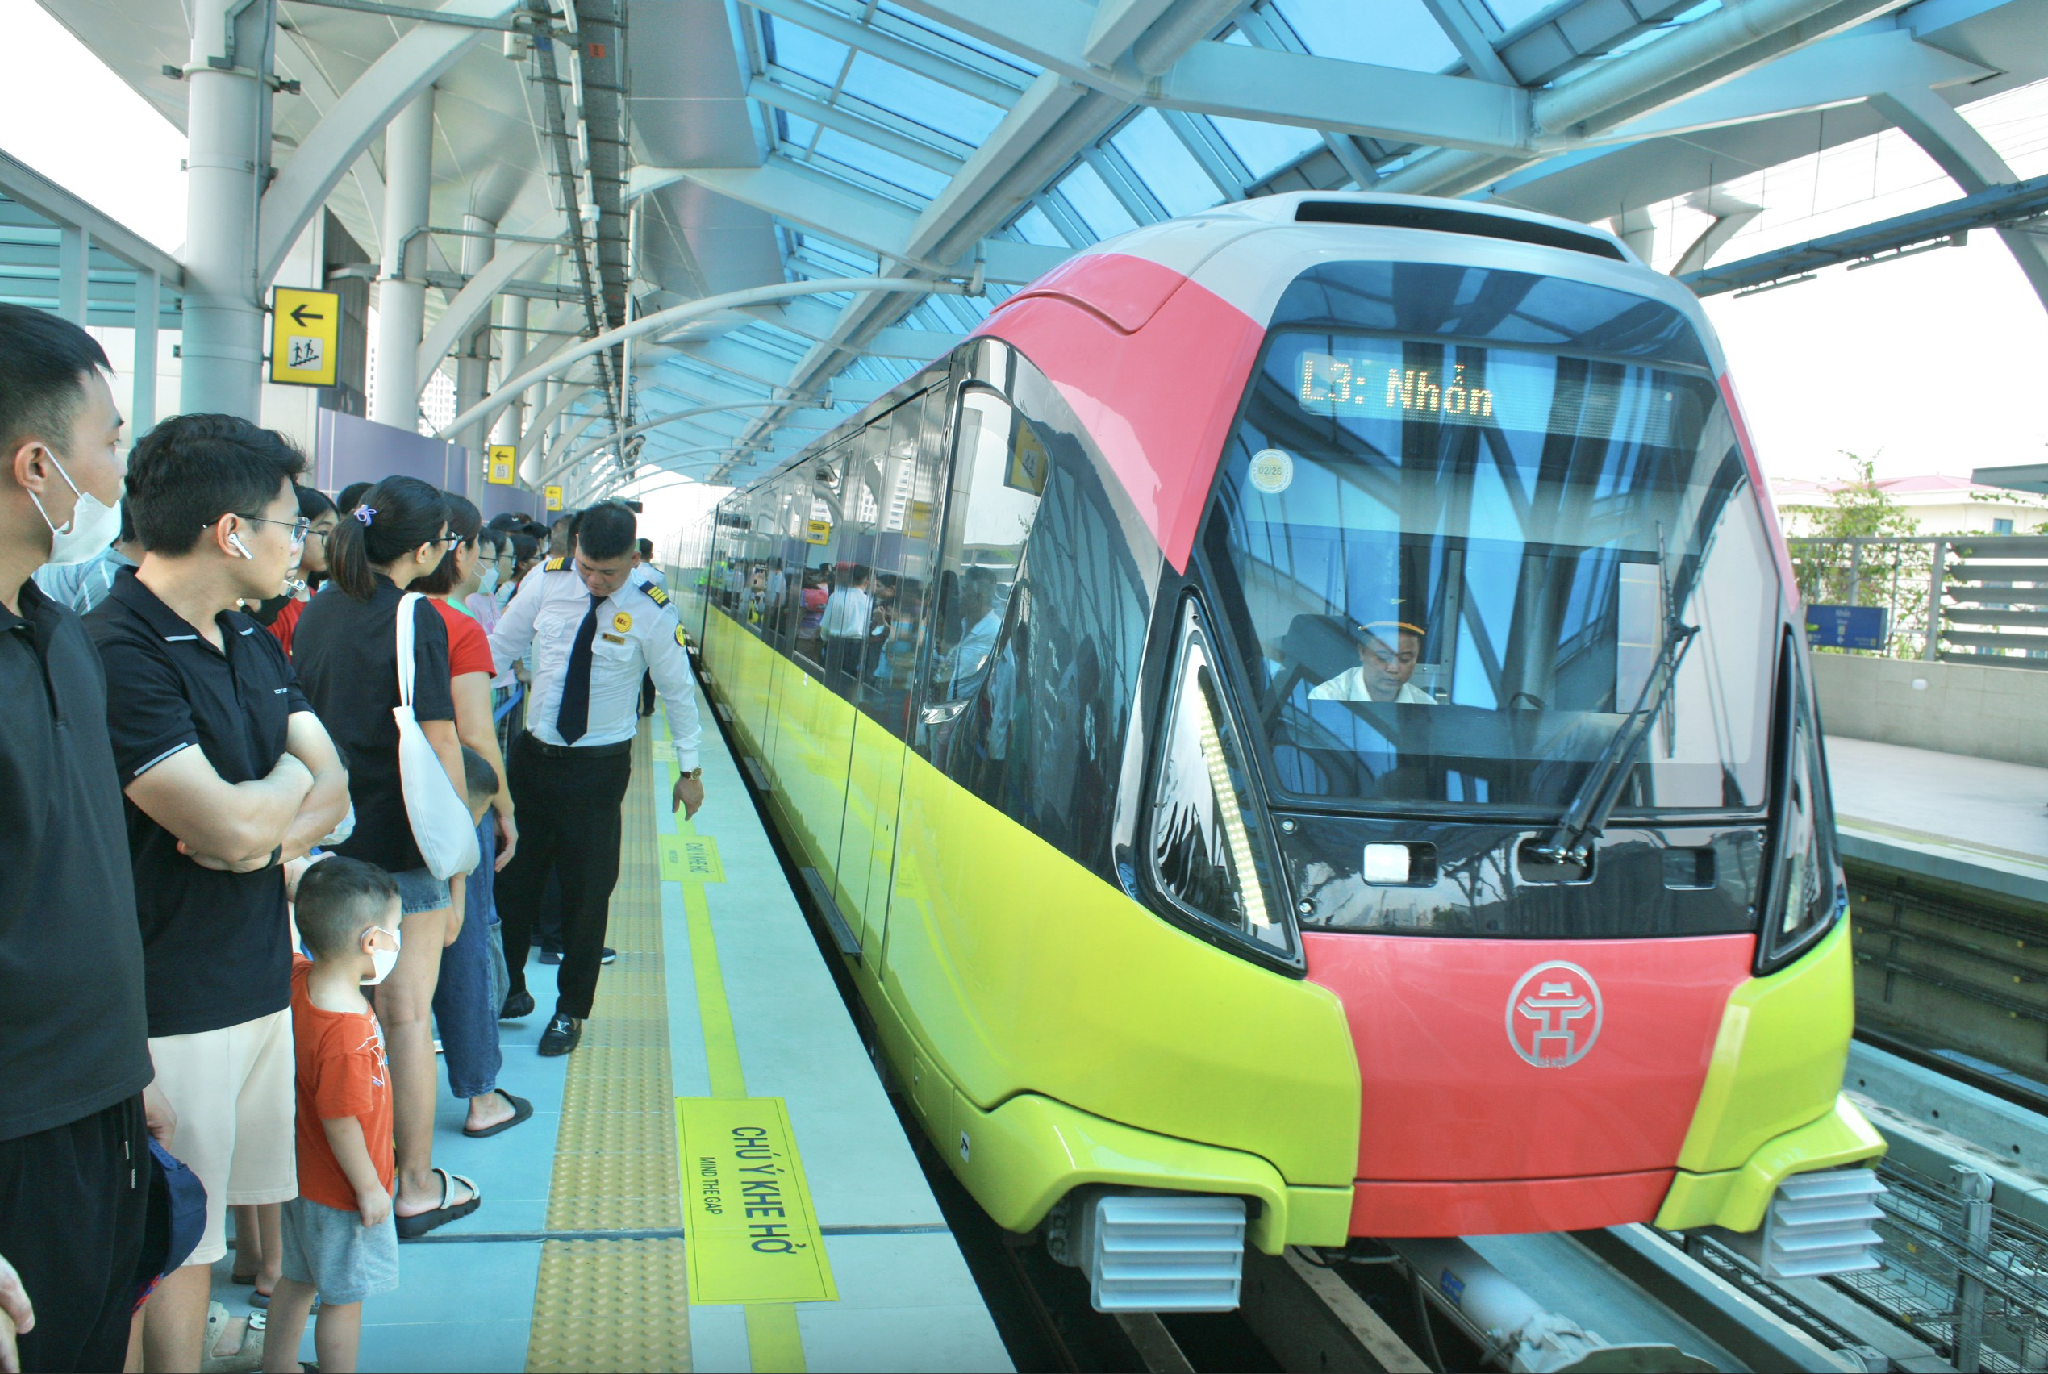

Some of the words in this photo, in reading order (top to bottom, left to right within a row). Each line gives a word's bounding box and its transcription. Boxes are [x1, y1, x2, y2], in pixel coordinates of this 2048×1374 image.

[1302, 359, 1366, 405] L3:
[1386, 362, 1493, 417] Nhổn
[731, 1127, 781, 1159] CHÚ
[699, 1157, 718, 1176] MIND
[738, 1163, 785, 1176] Ý
[702, 1178, 720, 1195] THE
[703, 1196, 723, 1215] GAP
[740, 1180, 786, 1219] KHE
[748, 1224, 807, 1254] HỞ
